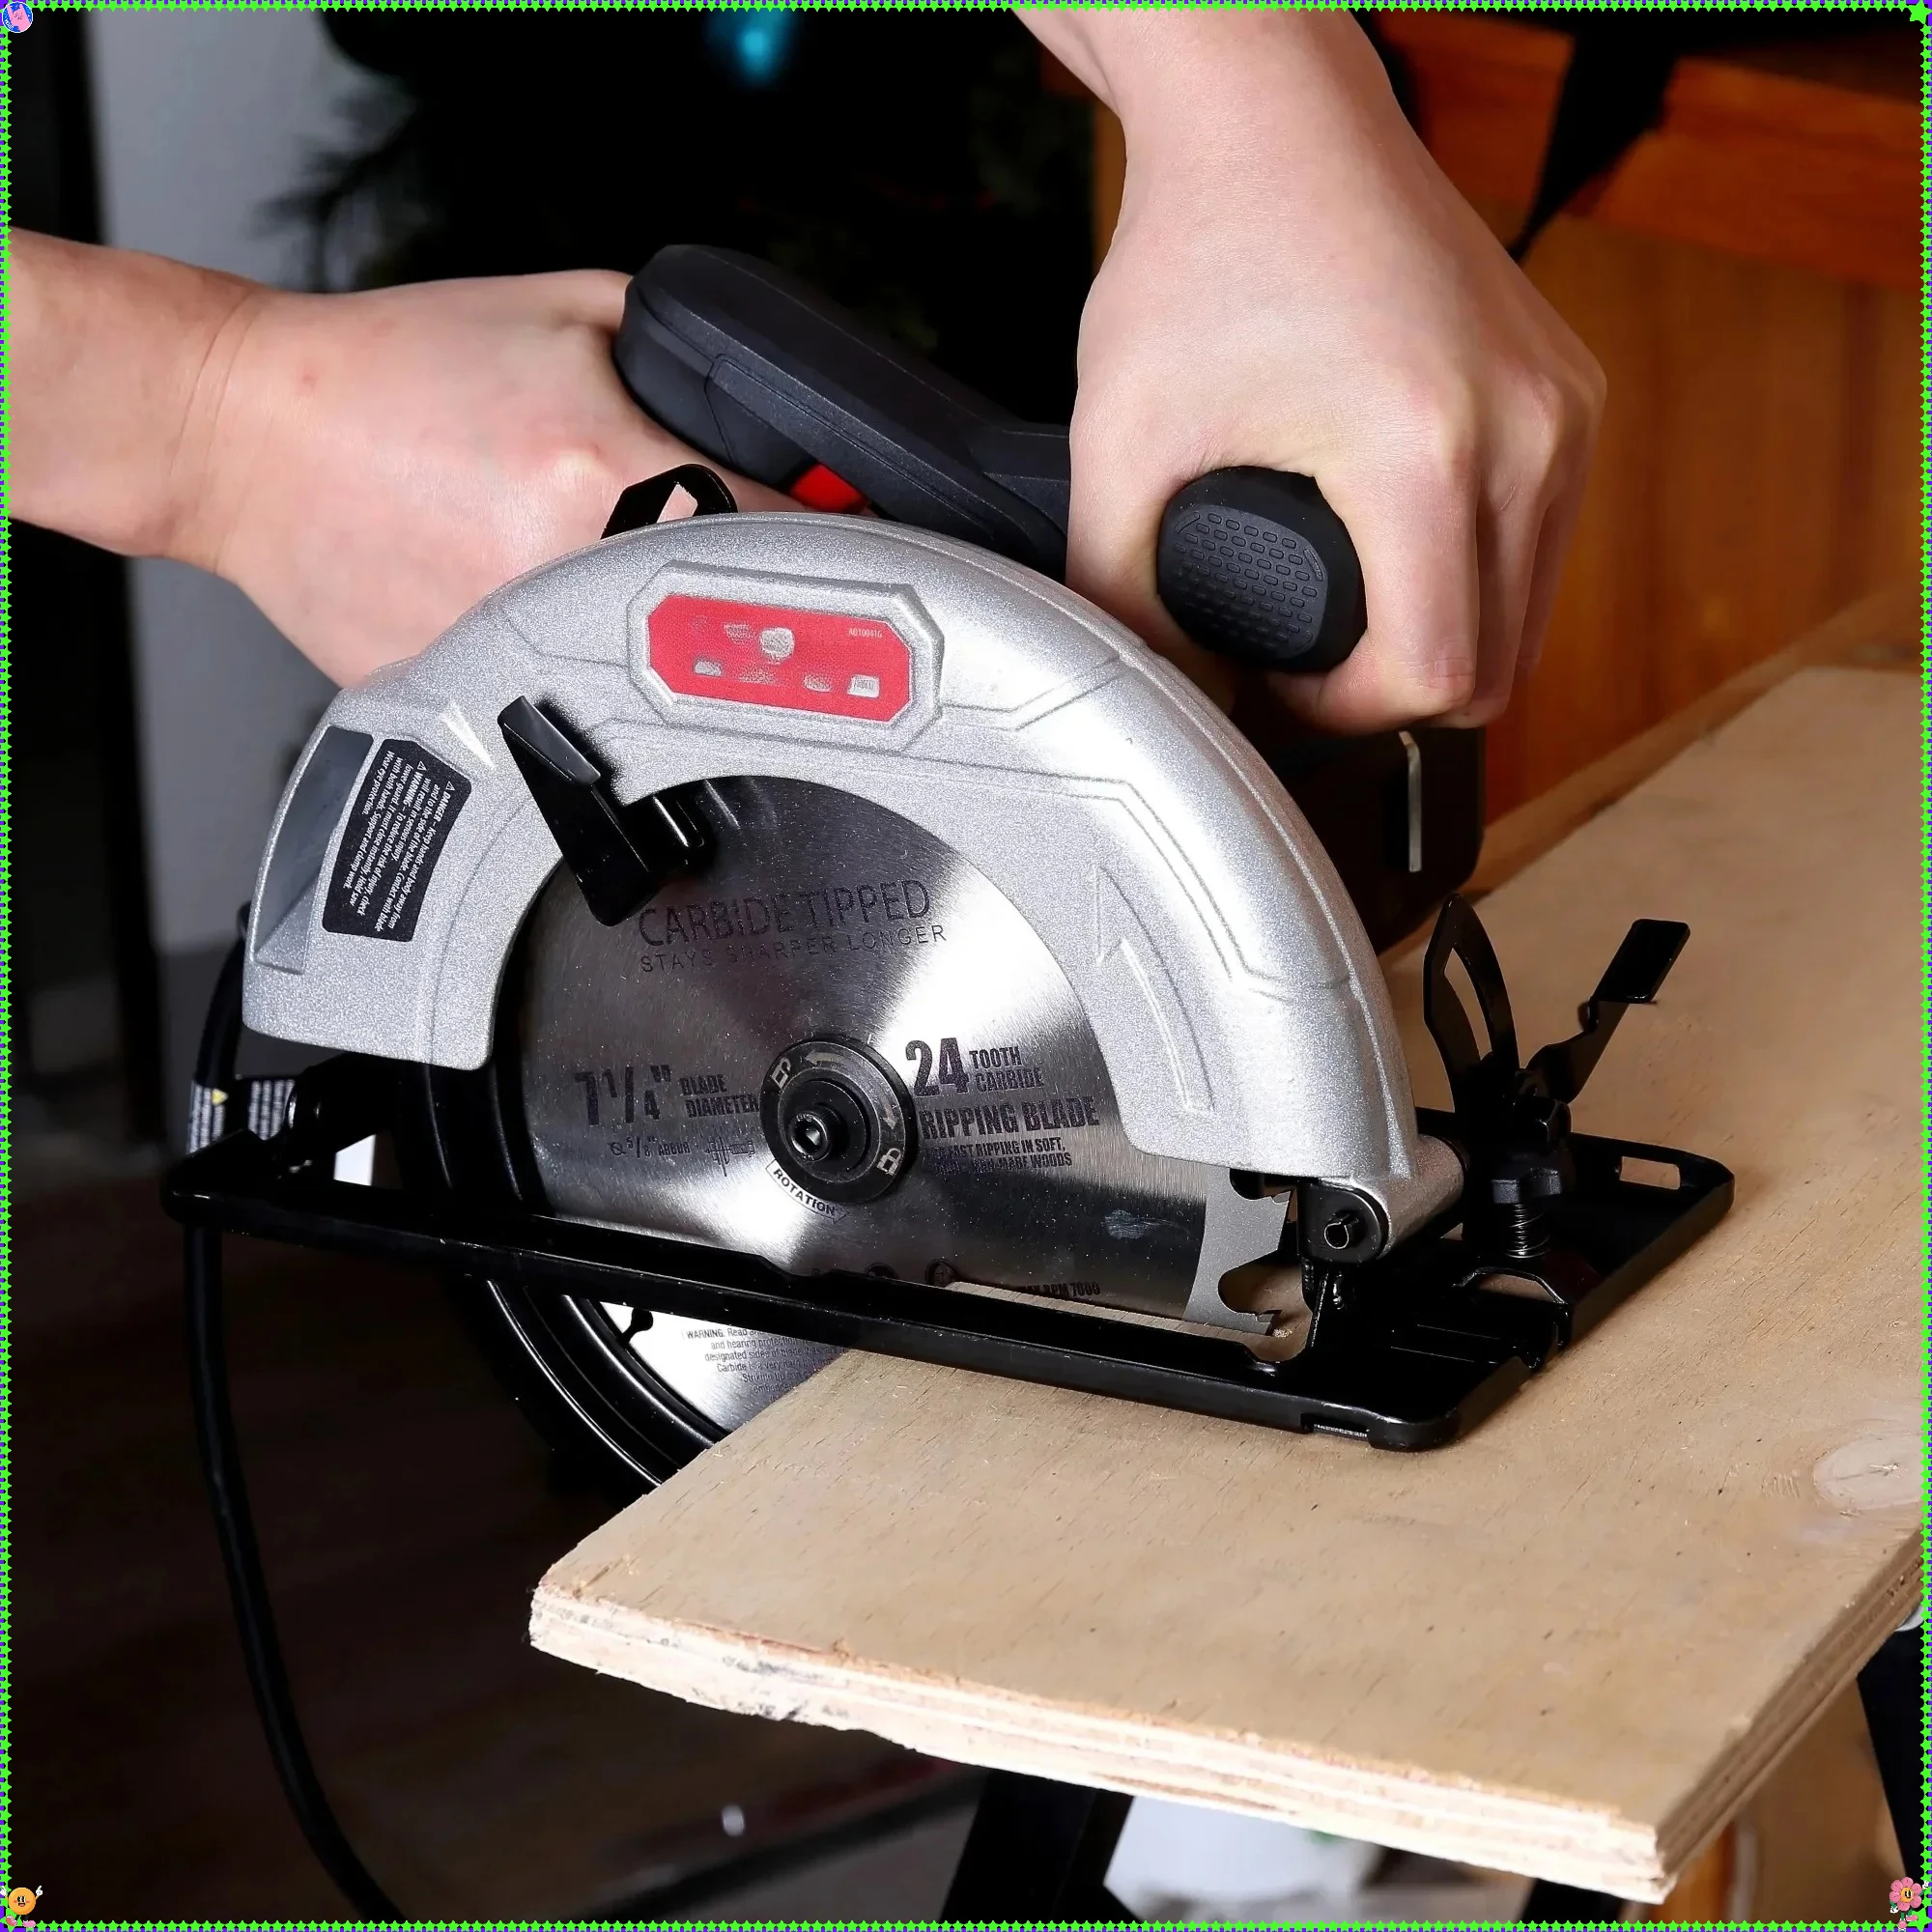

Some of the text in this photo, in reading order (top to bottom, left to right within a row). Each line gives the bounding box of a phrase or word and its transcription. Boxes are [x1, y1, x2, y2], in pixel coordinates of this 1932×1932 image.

[391, 756, 404, 774] with
[400, 763, 414, 784] lower
[361, 750, 395, 815] Wear eye protection.
[384, 772, 398, 790] both
[403, 771, 423, 808] WARNING
[390, 781, 404, 806] guard.
[430, 783, 440, 801] and
[387, 804, 397, 813] It
[421, 806, 433, 819] the
[427, 798, 437, 808] to
[433, 791, 451, 822] DANGER
[364, 810, 382, 839] Support
[380, 810, 392, 831] must
[390, 778, 432, 862] will result in serious injury.
[396, 811, 407, 822] To
[415, 817, 427, 833] side
[373, 828, 386, 846] close
[386, 820, 401, 844] reduce
[412, 832, 421, 843] of
[422, 826, 437, 845] Keep
[359, 837, 369, 854] and
[382, 842, 393, 856] the
[408, 839, 418, 853] the
[414, 843, 430, 866] hands
[350, 850, 364, 871] clamp
[377, 854, 387, 868] risk
[343, 870, 355, 889] work.
[373, 867, 382, 878] of
[409, 864, 419, 880] and
[354, 875, 367, 895] Hold
[388, 872, 405, 898] Contact
[401, 876, 415, 895] body
[349, 891, 359, 907] saw
[356, 895, 370, 916] check
[382, 896, 395, 914] with
[393, 894, 407, 914] away
[374, 912, 388, 932] blade
[387, 911, 401, 929] from
[639, 880, 930, 947] CARBIDE TIPPED
[640, 924, 948, 973] STAYS SHARPER LONGER
[905, 1037, 1022, 1096] 24 TOOTH
[679, 1074, 727, 1095] BLADE
[976, 1067, 1044, 1093] CARBIDE
[686, 1094, 760, 1118] DIAMETER
[919, 1095, 1099, 1139] RIPPING BLADE
[659, 1141, 692, 1156] ARBOR
[976, 1140, 1020, 1157] RIPPING
[1021, 1139, 1035, 1153] IN
[1035, 1137, 1066, 1153] SOFT,
[1030, 1151, 1073, 1169] WOODS
[774, 1167, 836, 1216] ROTATION
[1069, 1280, 1101, 1296] 7000
[727, 1327, 748, 1338] Read
[711, 1341, 725, 1350] and
[726, 1339, 756, 1349] hearing
[704, 1350, 747, 1363] designated
[749, 1350, 770, 1359] sides
[772, 1349, 779, 1357] of
[717, 1362, 747, 1373] Carbide
[764, 1361, 781, 1371] very
[742, 1372, 772, 1383] Striking
